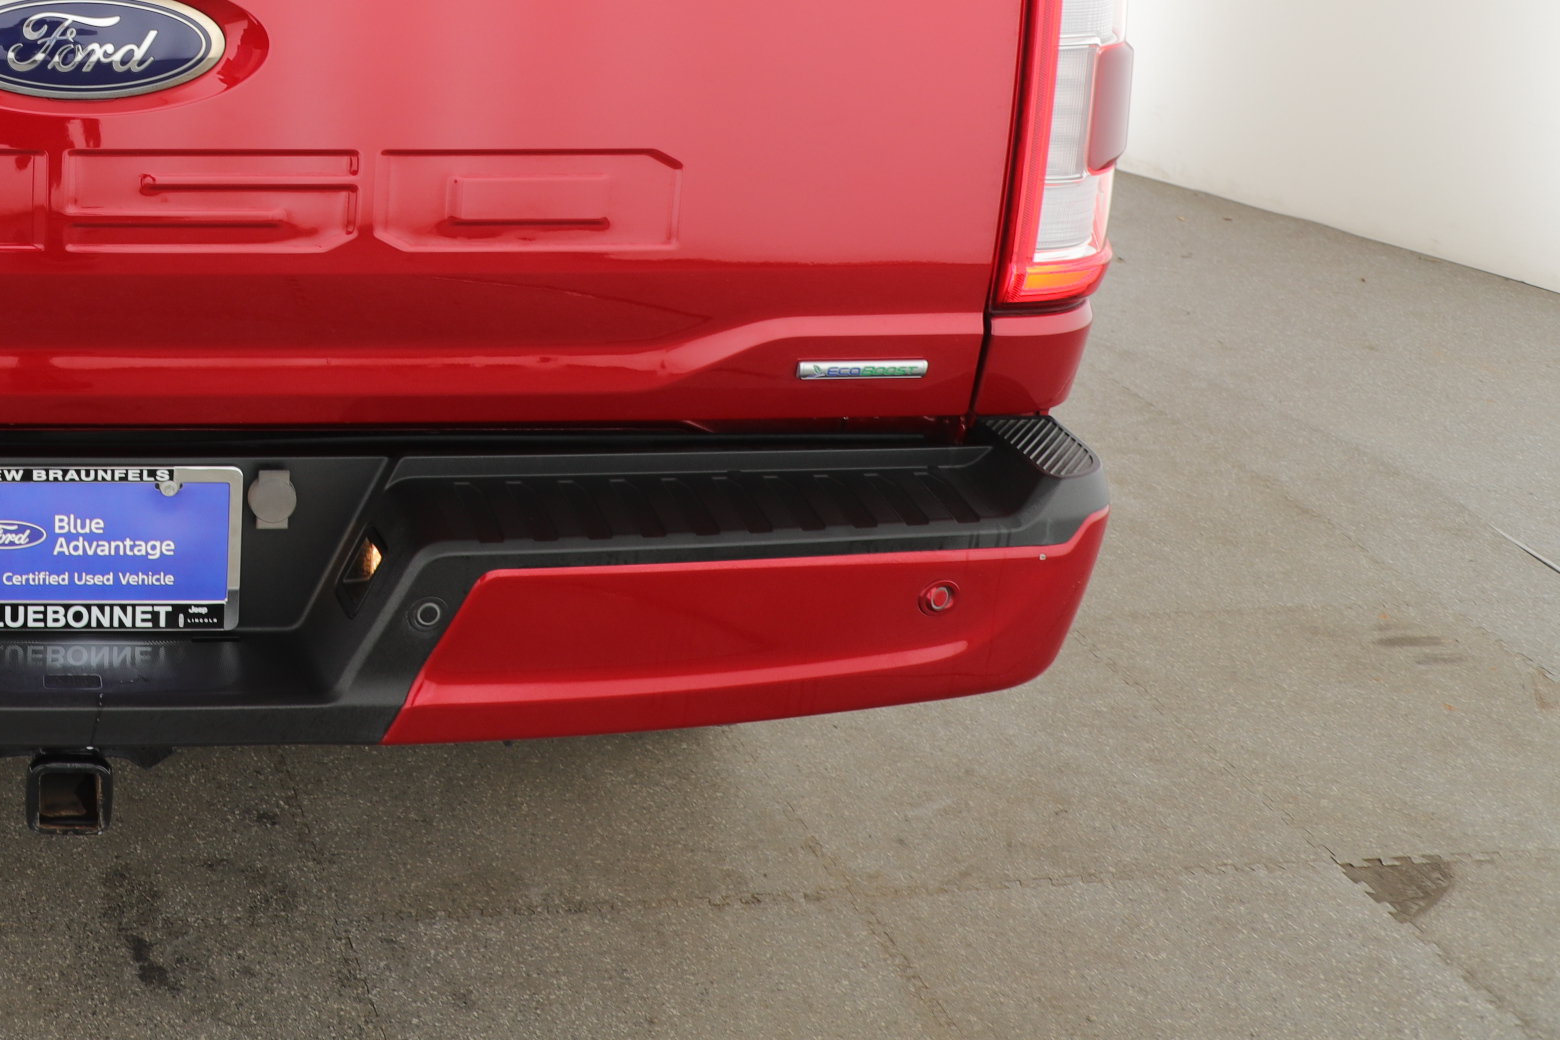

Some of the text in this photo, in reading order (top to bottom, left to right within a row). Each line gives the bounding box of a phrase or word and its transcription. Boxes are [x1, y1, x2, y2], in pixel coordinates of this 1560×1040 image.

[6, 11, 159, 73] Ford
[32, 469, 171, 481] BRAUNFELS
[53, 513, 105, 534] Blue
[53, 536, 176, 560] Advantage
[2, 571, 69, 586] Certified
[74, 571, 114, 586] Used
[119, 571, 175, 586] Vehicle
[188, 605, 209, 615] Jeep
